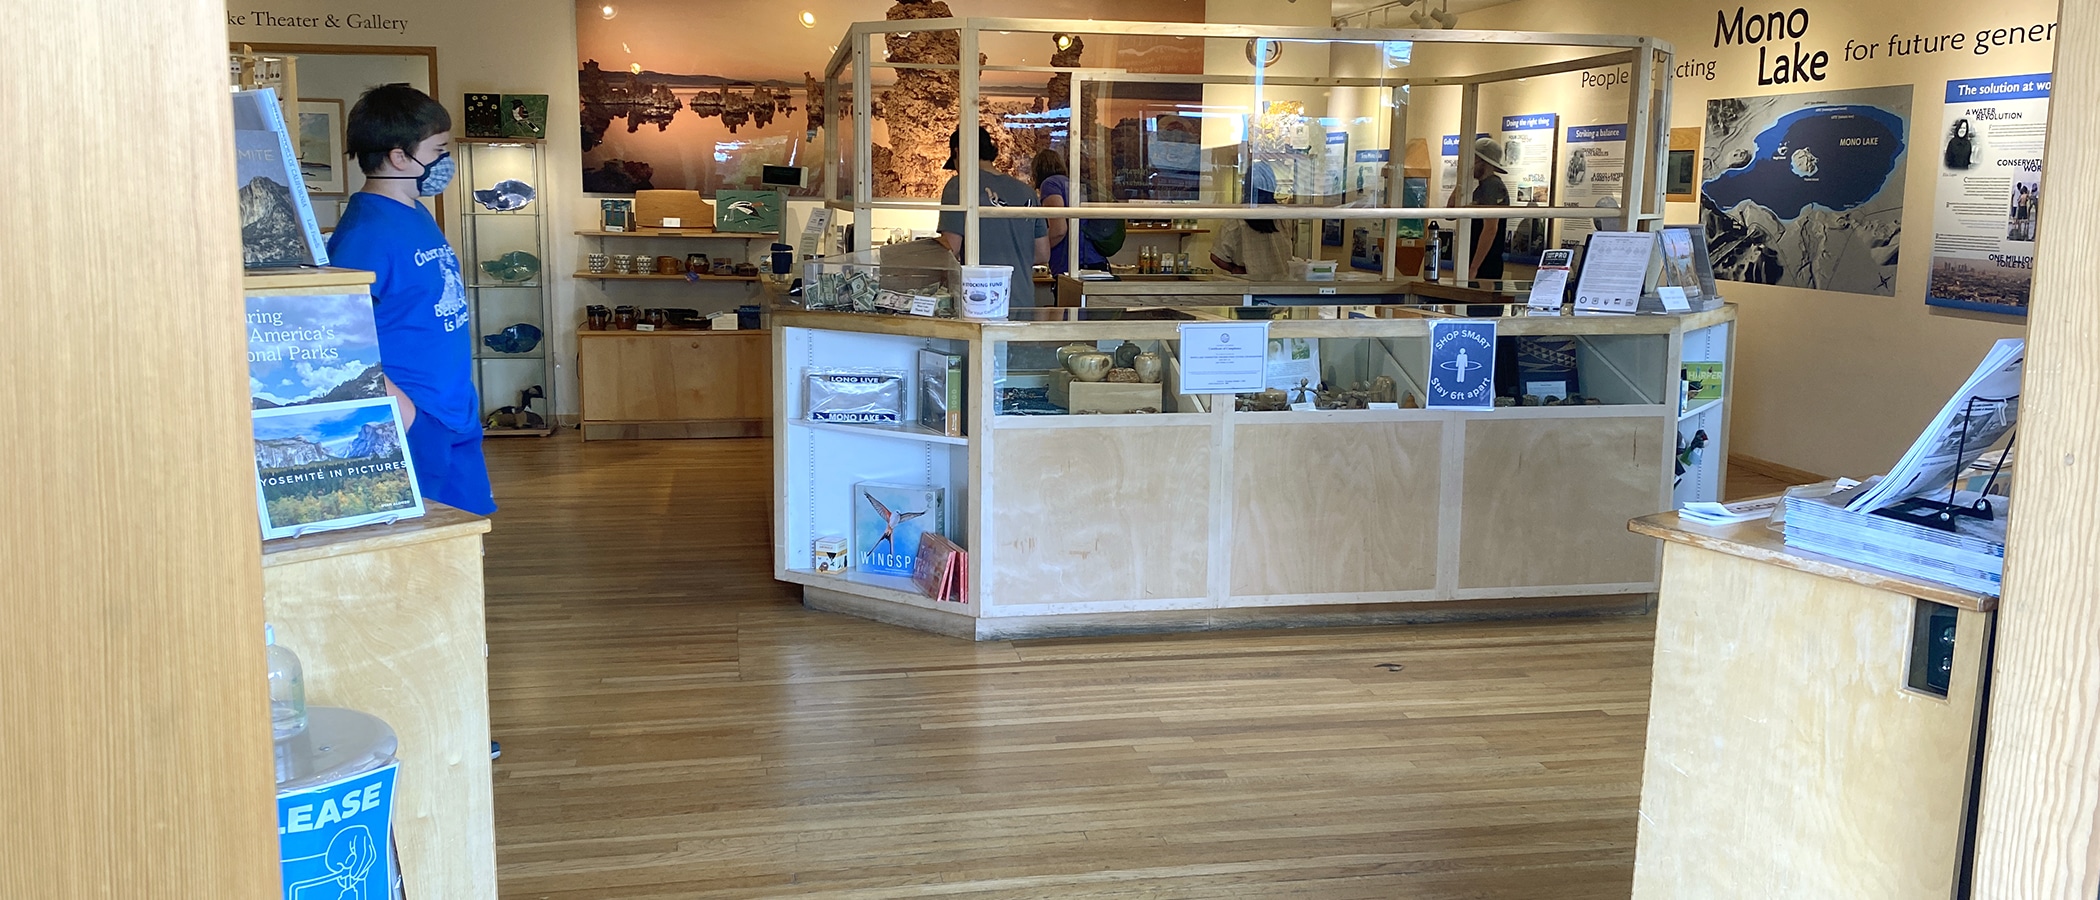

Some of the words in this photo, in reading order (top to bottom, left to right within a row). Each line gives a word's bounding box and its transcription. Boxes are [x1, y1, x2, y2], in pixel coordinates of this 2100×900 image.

[250, 11, 319, 28] Theater
[324, 14, 341, 28] &
[346, 13, 408, 34] Gallery
[1714, 6, 1809, 48] Mono
[1844, 39, 1880, 62] for
[1888, 34, 1966, 58] future
[1974, 22, 2058, 56] gener
[1758, 41, 1829, 86] Lake
[1582, 67, 1629, 90] People
[1958, 84, 1977, 96] The
[1978, 82, 2020, 94] solution
[2022, 81, 2036, 92] at
[1972, 108, 1996, 116] WATER
[1976, 112, 2022, 121] REVOLUTION
[1506, 119, 1520, 128] Doing
[1526, 118, 1538, 128] right
[1538, 117, 1550, 126] thing
[1576, 130, 1596, 139] Striking
[1840, 138, 1862, 146] MONO
[1862, 137, 1878, 146] LAKE
[238, 150, 274, 162] MITE
[291, 165, 308, 208] CALIFORNIA
[1996, 260, 2026, 268] TOILETS
[246, 308, 283, 326] ring
[444, 318, 455, 332] is
[250, 326, 335, 343] America's
[1436, 330, 1460, 350] SHOP
[1461, 330, 1491, 349] SMART
[290, 344, 338, 361] Parks
[1430, 377, 1448, 398] Stay
[1450, 391, 1464, 400] 6ft
[1467, 377, 1490, 398] apart
[260, 471, 325, 487] YOSEMITE
[330, 469, 342, 478] IN
[348, 460, 406, 477] PICTURES
[860, 550, 912, 568] WINGSP
